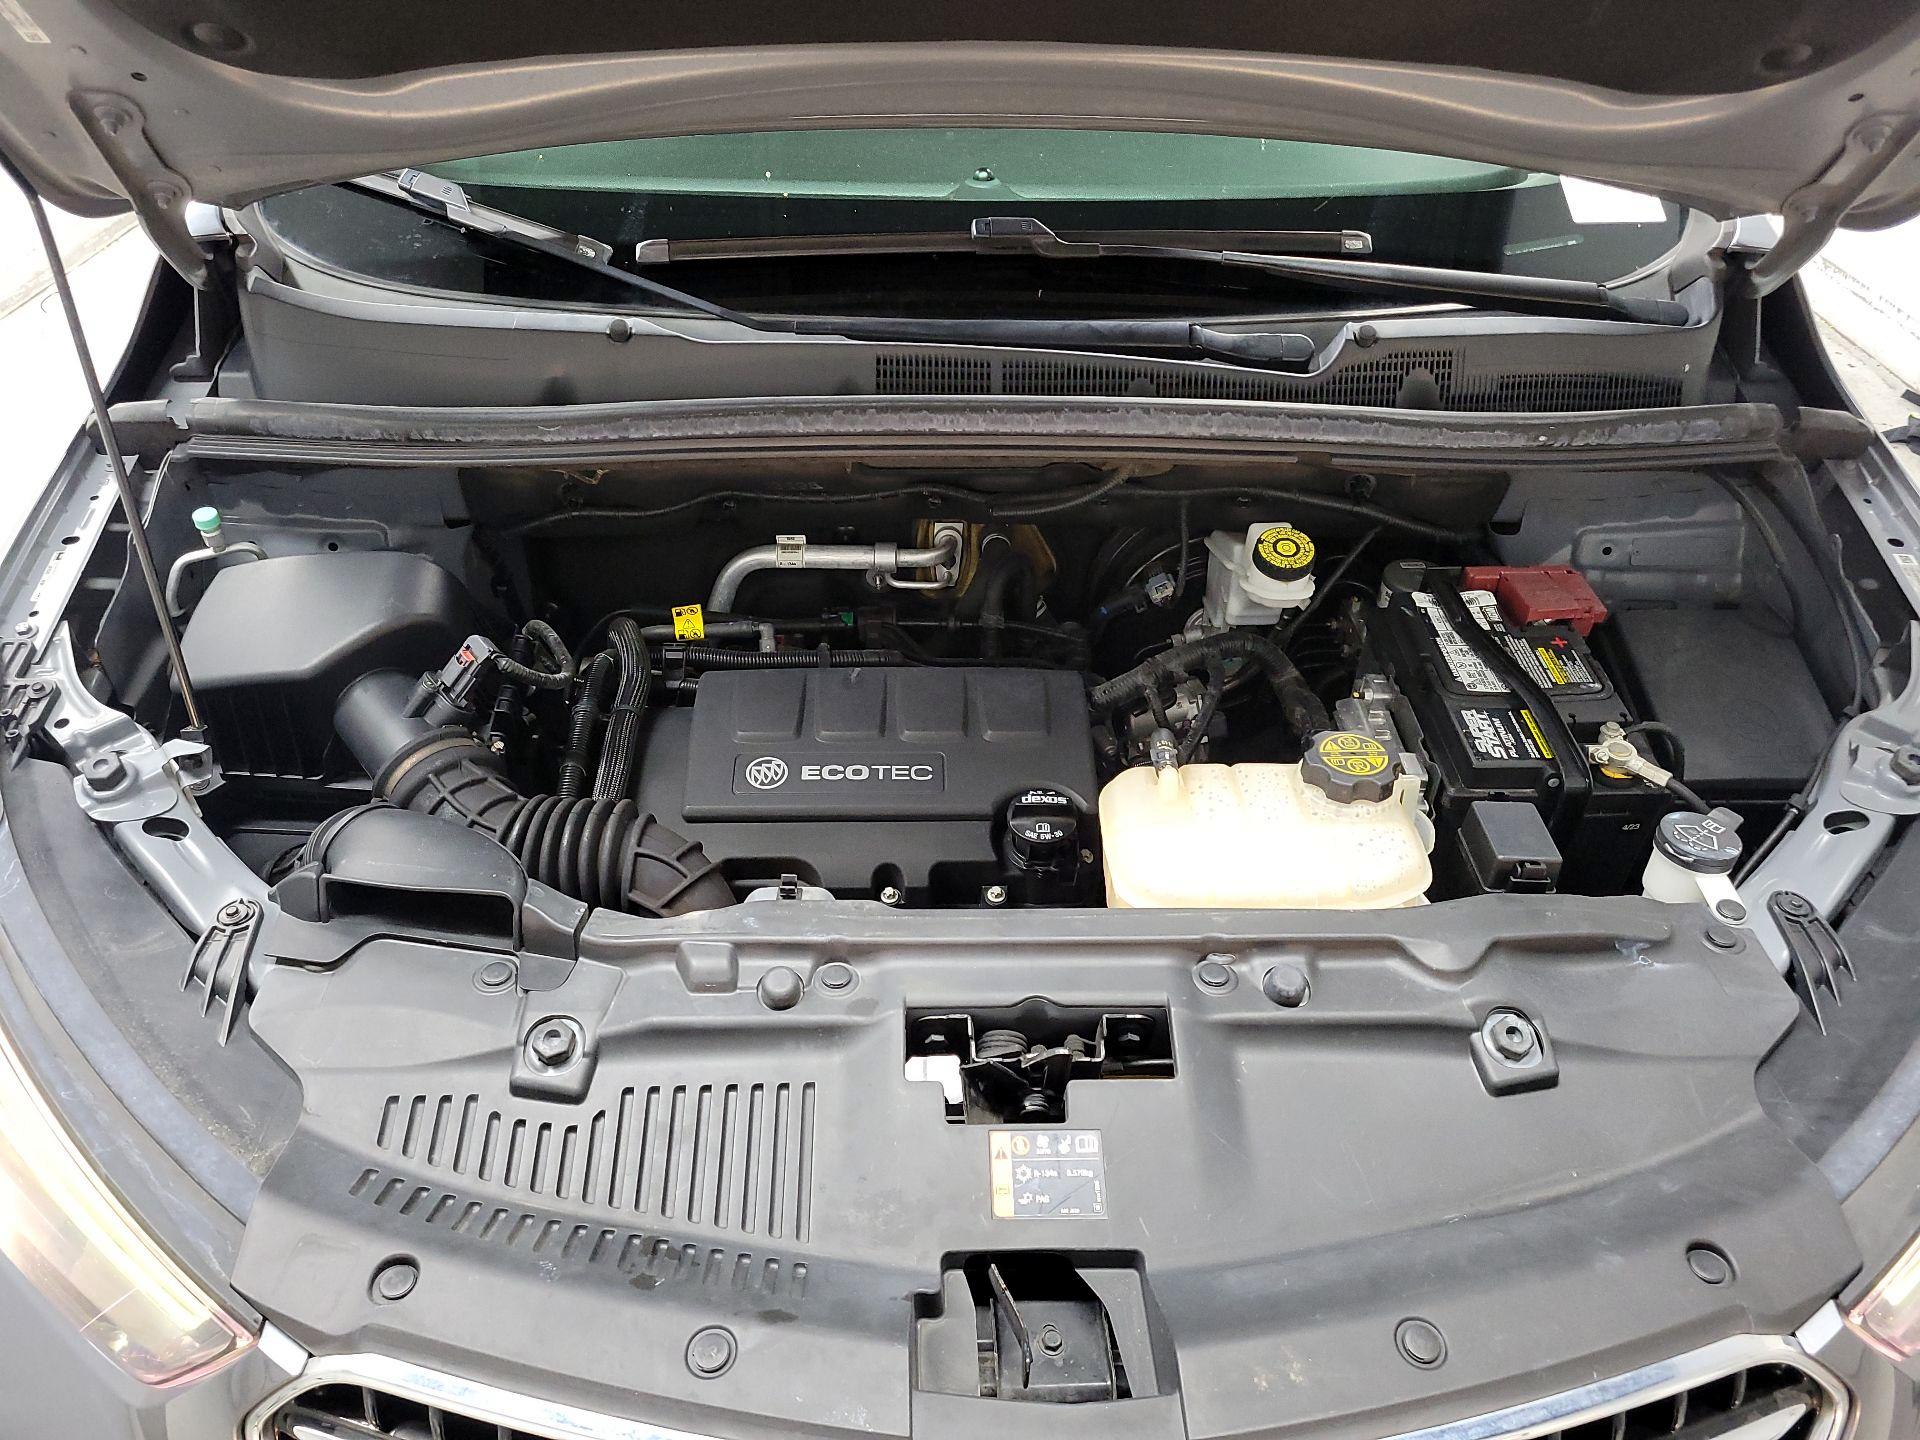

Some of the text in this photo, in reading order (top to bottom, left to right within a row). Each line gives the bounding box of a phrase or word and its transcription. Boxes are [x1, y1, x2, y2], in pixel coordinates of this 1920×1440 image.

[1461, 709, 1487, 752] SUPER
[1471, 710, 1509, 759] START
[1492, 717, 1519, 757] PLATINUM
[801, 765, 933, 781] ECOTEC
[1021, 793, 1068, 804] dexos
[1025, 829, 1038, 840] SAE
